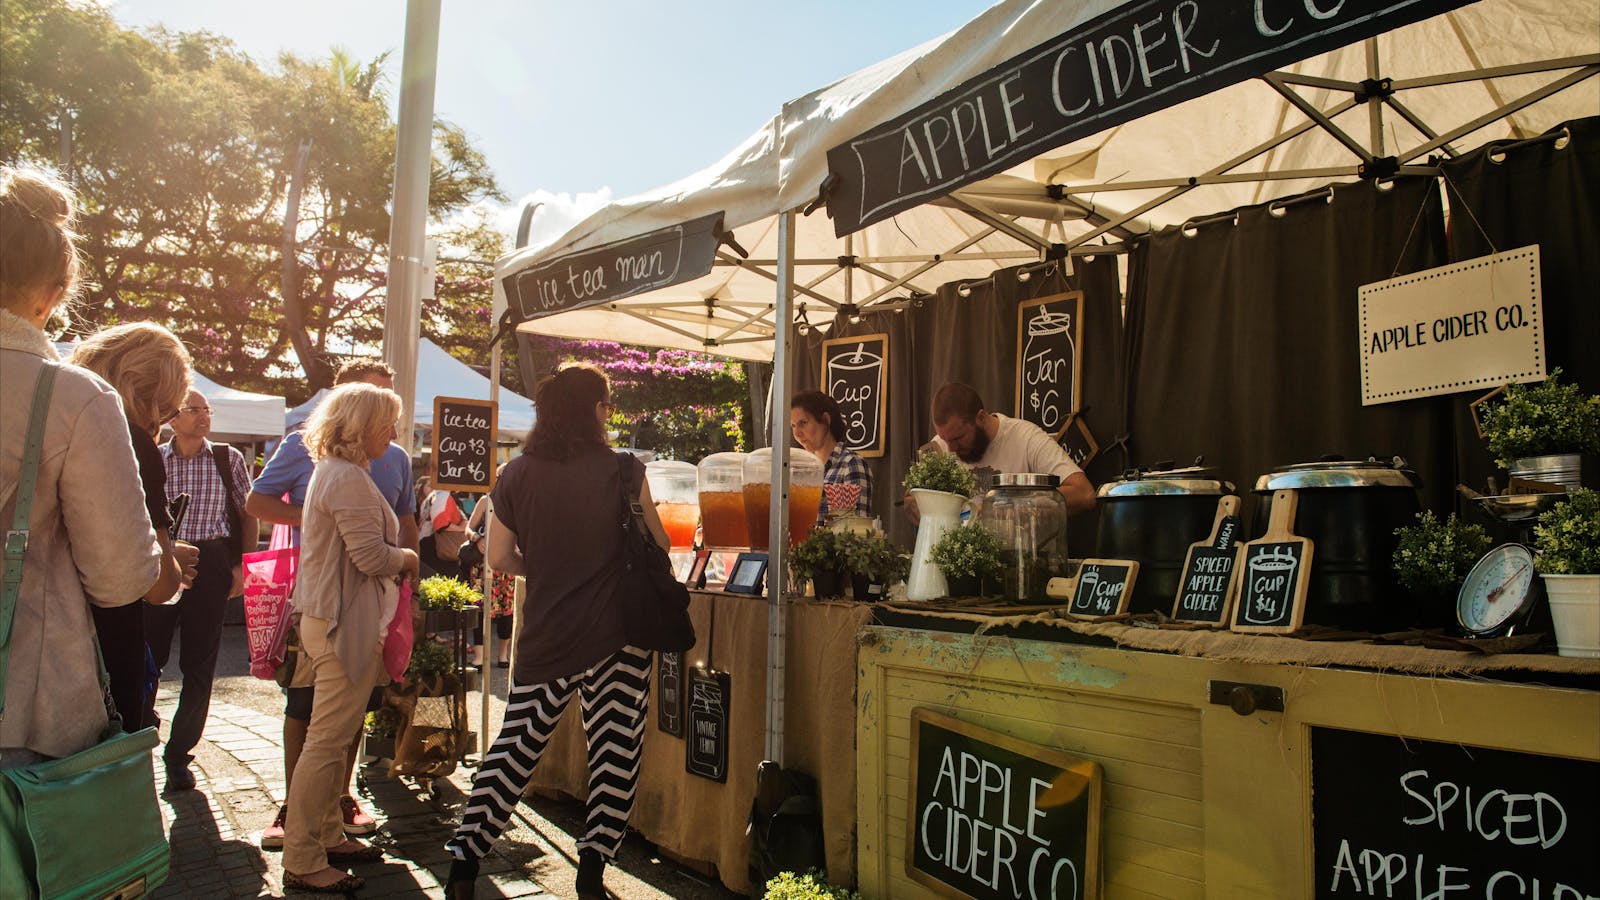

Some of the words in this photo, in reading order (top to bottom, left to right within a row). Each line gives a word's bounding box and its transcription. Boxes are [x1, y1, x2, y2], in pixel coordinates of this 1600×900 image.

[898, 71, 1034, 194] APPLE
[1051, 0, 1220, 118] CIDER
[1253, 0, 1347, 38] C
[536, 278, 566, 310] ice
[567, 264, 607, 300] tea
[616, 250, 665, 283] man
[1370, 321, 1427, 355] APPLE
[1432, 310, 1489, 343] CIDER
[1495, 304, 1529, 332] CO.
[1026, 347, 1066, 386] Jar
[831, 379, 872, 408] Cup
[1029, 388, 1059, 428] $6
[443, 408, 464, 427] ice
[464, 413, 490, 430] tea
[439, 436, 467, 456] Cup
[468, 437, 486, 456] $3
[439, 459, 467, 478] Jar
[467, 461, 486, 482] $6
[1217, 522, 1235, 551] WARM
[1194, 557, 1232, 573] SPICED
[1188, 576, 1226, 592] APPLE
[1096, 597, 1112, 615] $4
[1184, 594, 1219, 611] CIDER
[1255, 596, 1276, 617] $4
[932, 745, 1054, 847] APPLE
[1400, 769, 1568, 850] SPICED
[921, 801, 1023, 900] CIDER
[1330, 839, 1471, 900] APPLE
